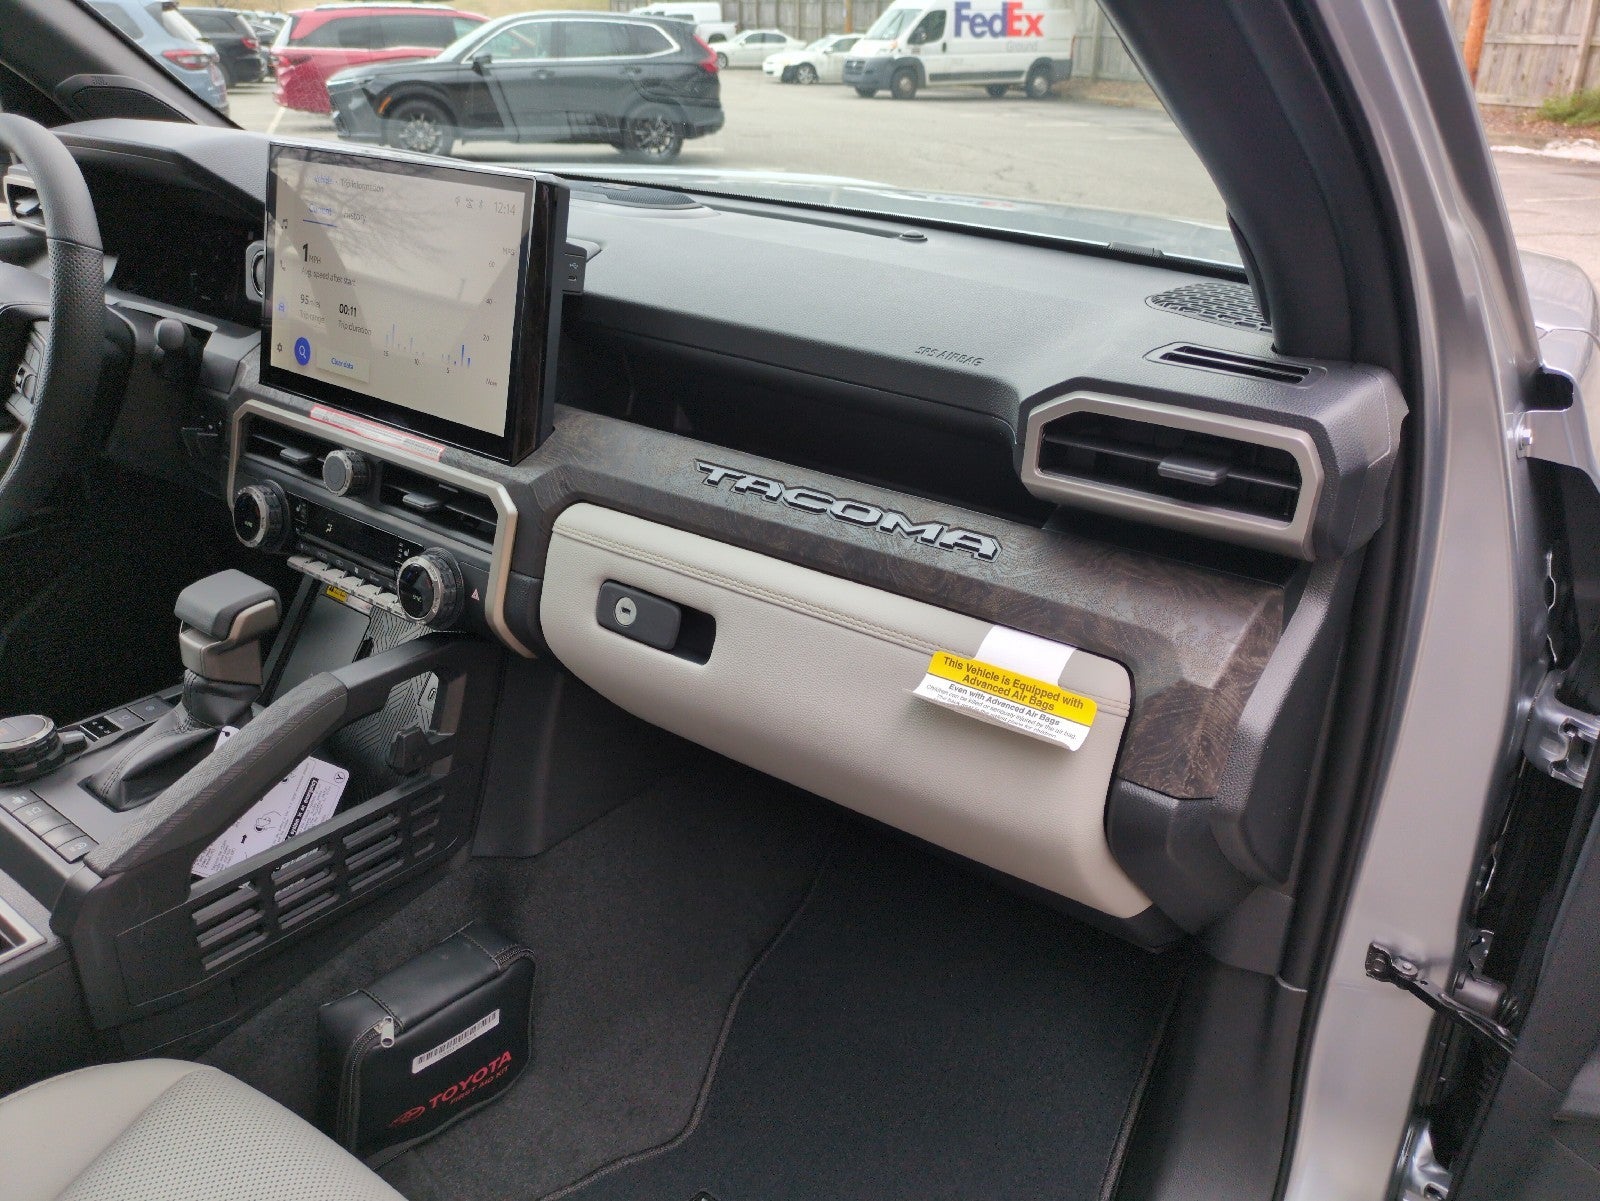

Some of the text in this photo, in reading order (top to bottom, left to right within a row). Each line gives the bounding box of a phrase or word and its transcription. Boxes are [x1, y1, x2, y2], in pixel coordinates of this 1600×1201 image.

[954, 1, 1044, 38] FedEx
[494, 201, 516, 216] 12:14
[302, 243, 309, 263] 1
[938, 350, 984, 367] AIRBAG
[696, 459, 1001, 562] TACOMA
[943, 656, 1084, 710] This Vehicle is Equipped with
[962, 674, 1055, 712] Advanced Air Bags
[949, 683, 968, 696] Even
[969, 690, 985, 700] with
[986, 695, 1024, 714] Advanced
[1025, 708, 1039, 718] Air
[1038, 712, 1061, 727] Bags
[1045, 724, 1055, 732] the
[429, 1051, 511, 1108] TOYOTA
